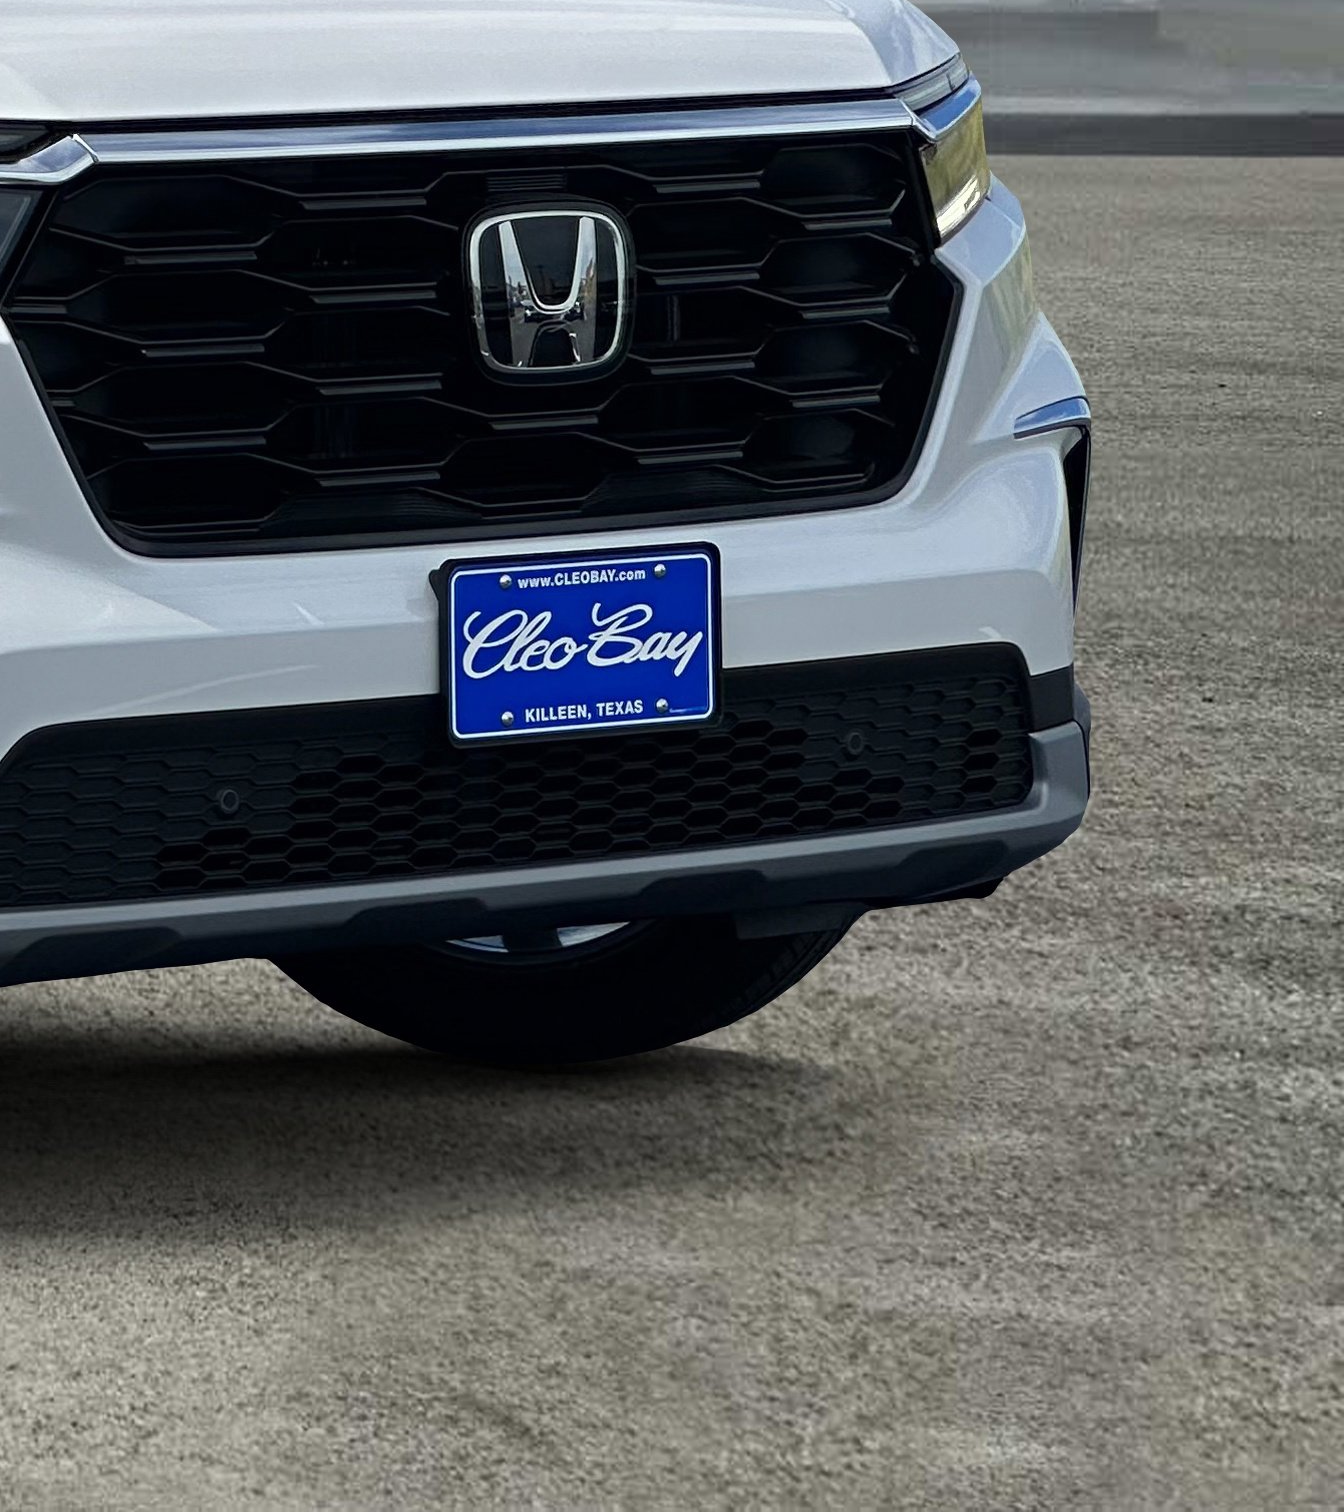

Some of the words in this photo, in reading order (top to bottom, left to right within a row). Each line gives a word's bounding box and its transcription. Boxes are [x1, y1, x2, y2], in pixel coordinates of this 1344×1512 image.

[517, 568, 647, 589] www.CLEOBAY.com
[462, 609, 588, 680] Cleo
[586, 602, 704, 678] Bay
[524, 703, 593, 723] KILLEEN,
[596, 699, 644, 718] TEXAS
